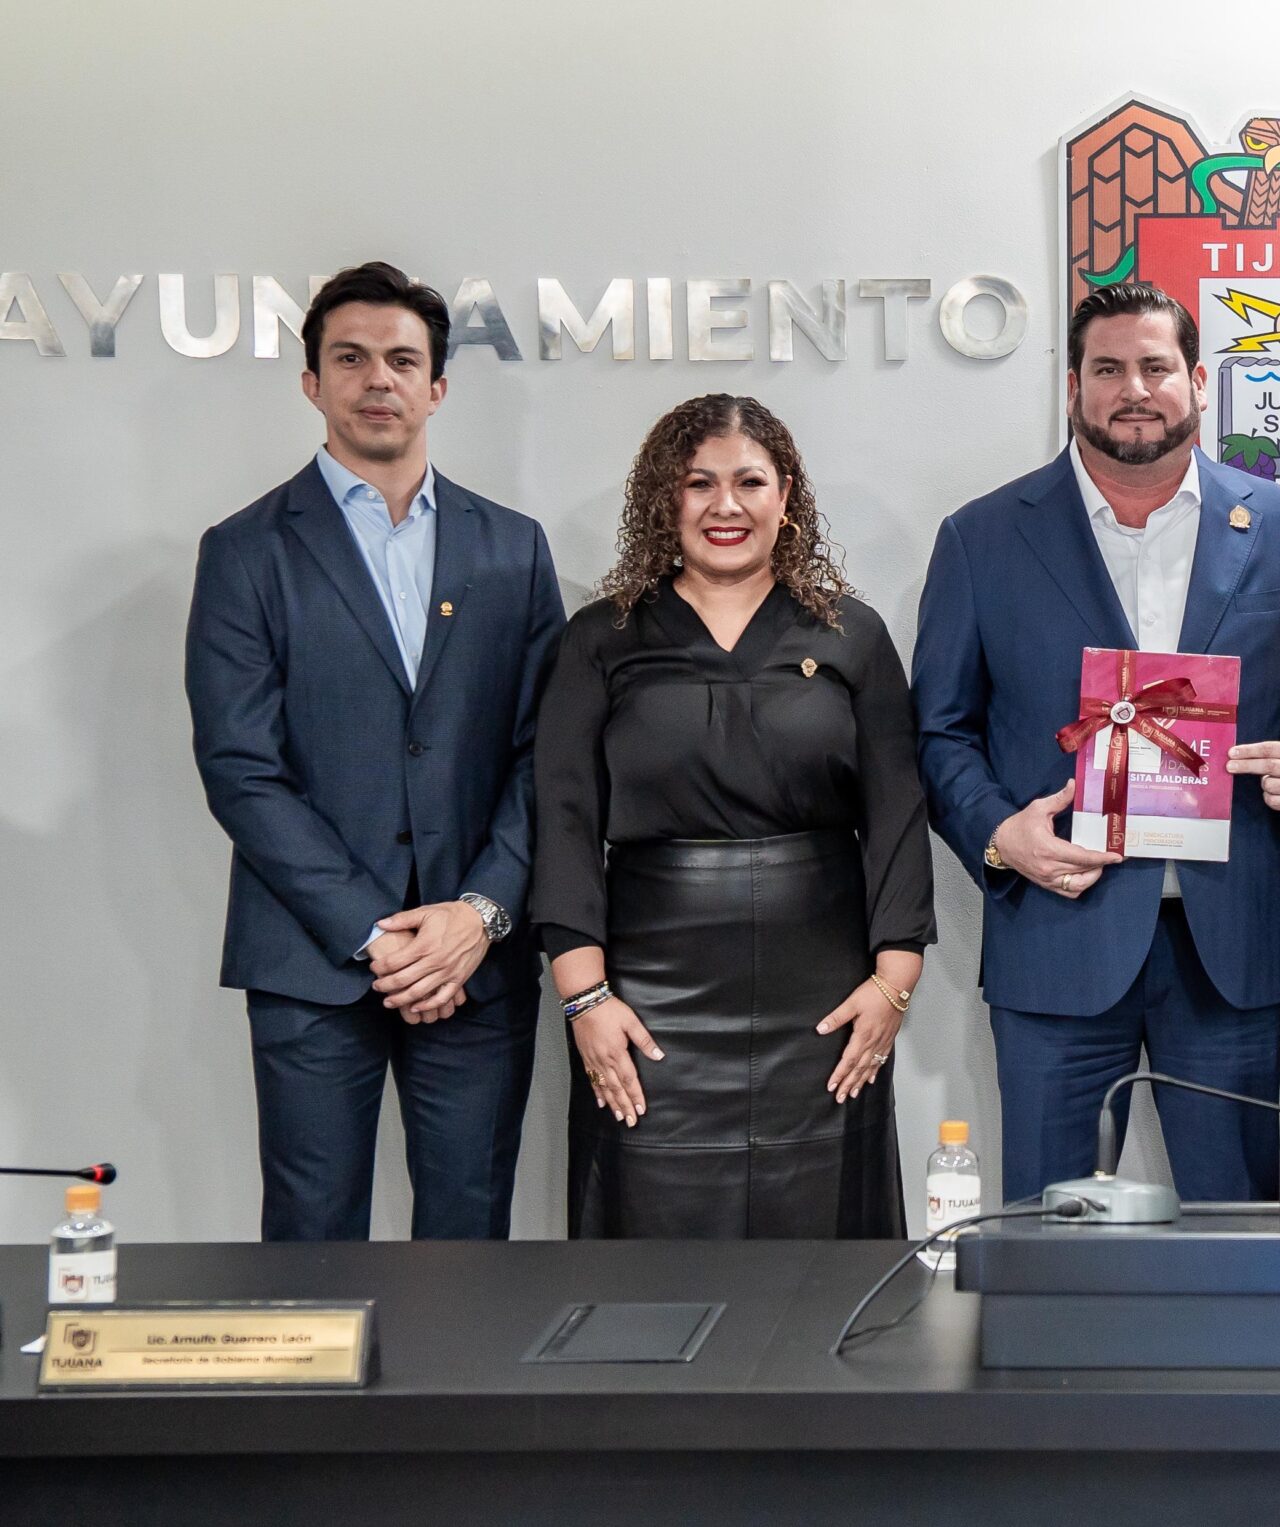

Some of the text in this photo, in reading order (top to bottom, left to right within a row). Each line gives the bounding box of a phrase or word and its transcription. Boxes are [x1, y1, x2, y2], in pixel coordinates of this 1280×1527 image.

[0, 273, 1029, 361] AYUNAMIENTO
[1130, 773, 1209, 785] SITA BALDERAS
[51, 1357, 103, 1369] TIJUANA
